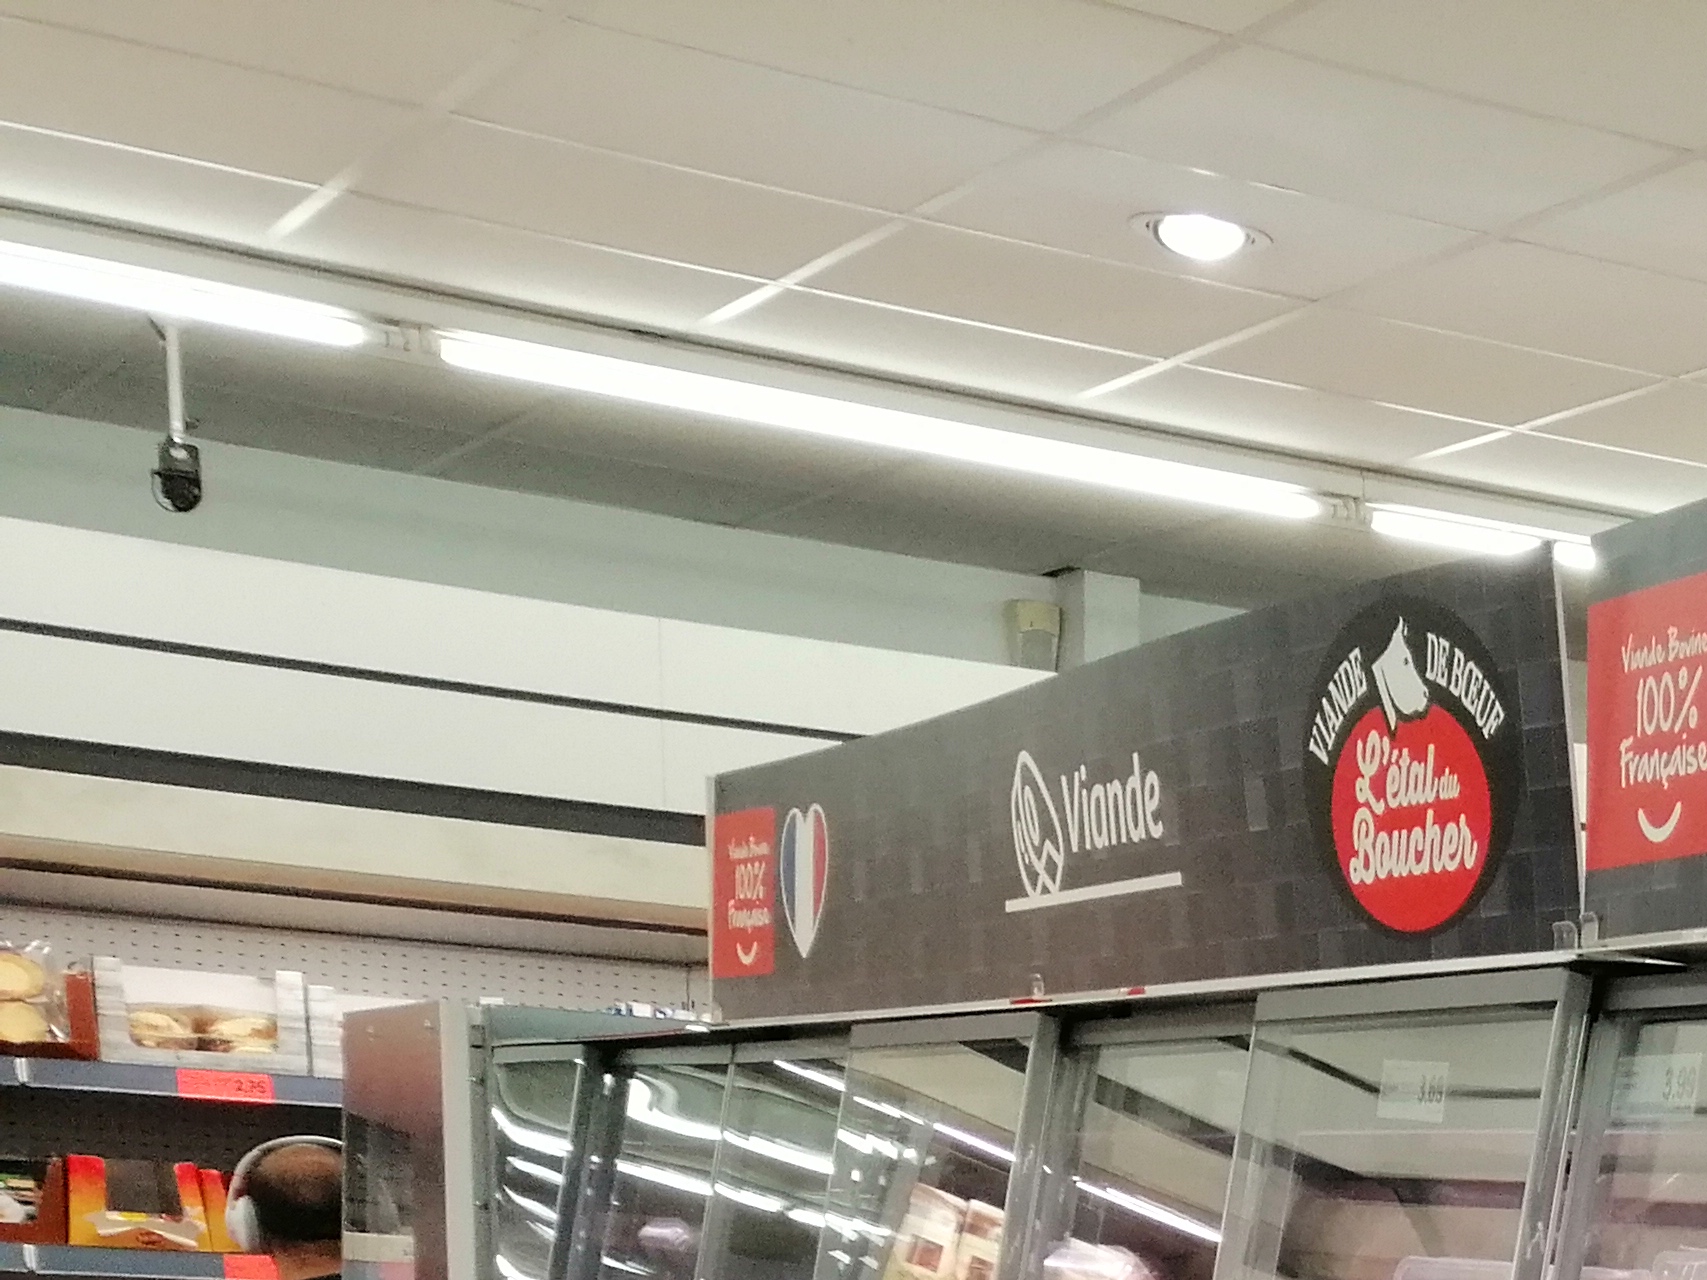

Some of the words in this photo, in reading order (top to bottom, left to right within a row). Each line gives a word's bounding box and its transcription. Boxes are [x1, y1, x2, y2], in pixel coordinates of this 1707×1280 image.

[1622, 634, 1665, 673] Viande
[1309, 647, 1367, 765] VIANDE
[1426, 632, 1449, 683] DE
[1636, 665, 1703, 738] 100%
[1061, 752, 1164, 853] Viande
[1356, 729, 1439, 815] L'étal
[1439, 767, 1460, 800] du
[1349, 778, 1478, 885] Boucher
[735, 861, 766, 900] 100%
